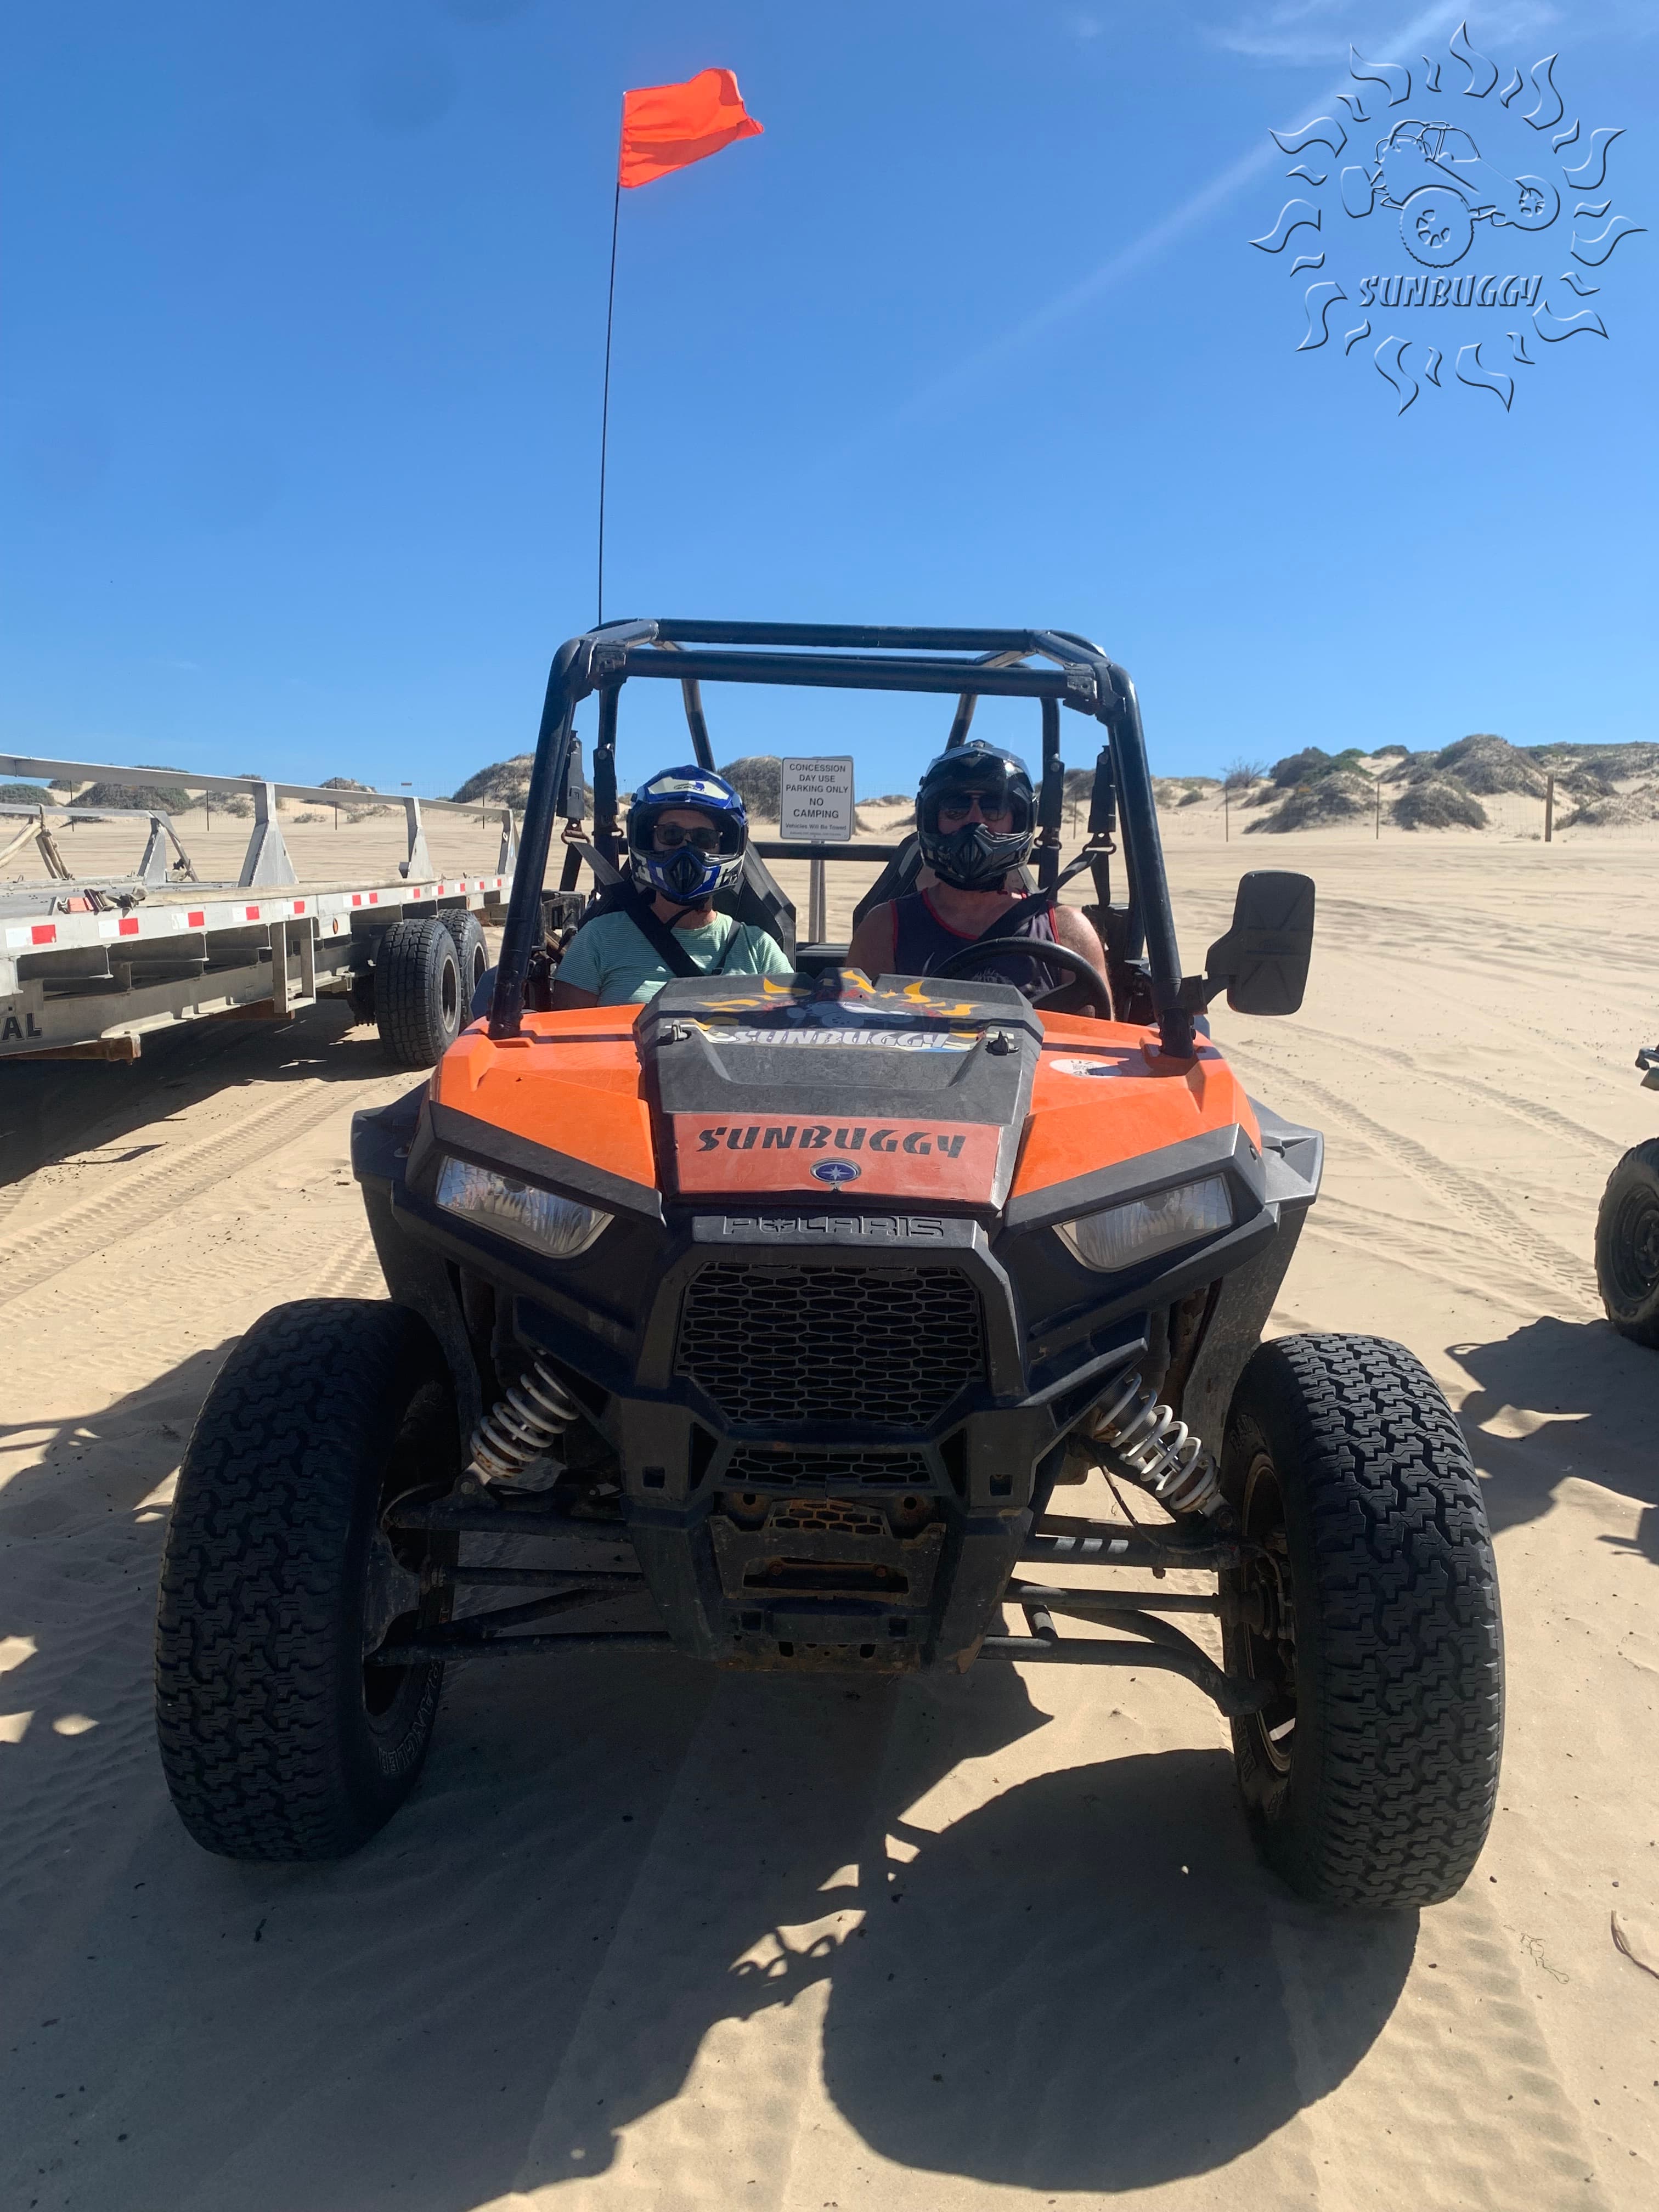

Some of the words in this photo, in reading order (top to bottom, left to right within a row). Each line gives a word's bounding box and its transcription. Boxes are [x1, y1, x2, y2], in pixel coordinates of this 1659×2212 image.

[789, 763, 846, 772] CONCESSION
[786, 785, 823, 793] PARKING
[809, 798, 824, 806] NO
[793, 809, 839, 819] CAMPING
[733, 1030, 950, 1048] SUNBUGGY
[696, 1125, 966, 1159] SUNBUGGY
[723, 1215, 944, 1239] POLARIS
